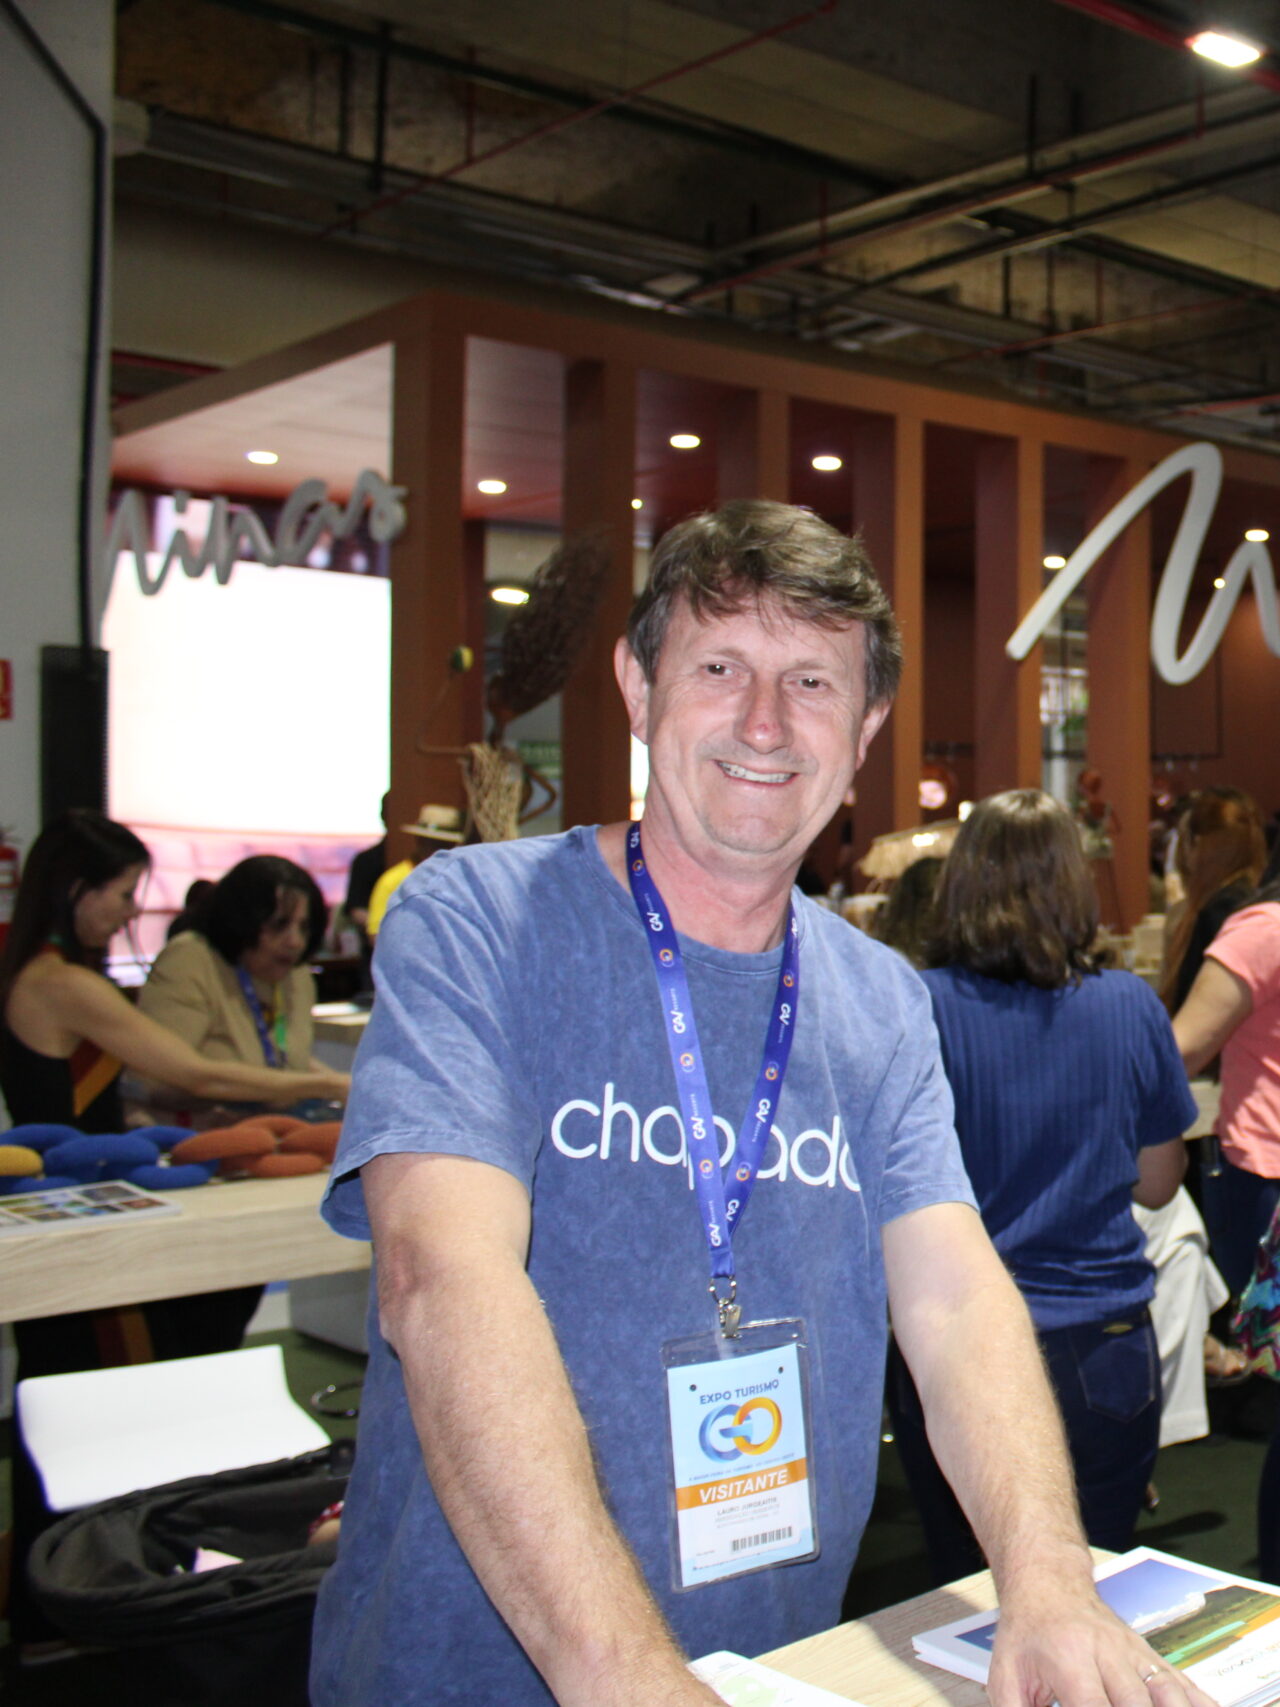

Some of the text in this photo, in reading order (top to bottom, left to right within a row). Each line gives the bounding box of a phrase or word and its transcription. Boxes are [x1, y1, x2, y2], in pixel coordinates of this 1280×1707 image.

[670, 1010, 686, 1034] GAV
[779, 1003, 791, 1026] GAV
[755, 1098, 771, 1123] GAV
[691, 1116, 707, 1140] GAV
[709, 1223, 722, 1247] GAV
[700, 1379, 779, 1405] EXPO TURISMO
[699, 1468, 788, 1503] VISITANTE
